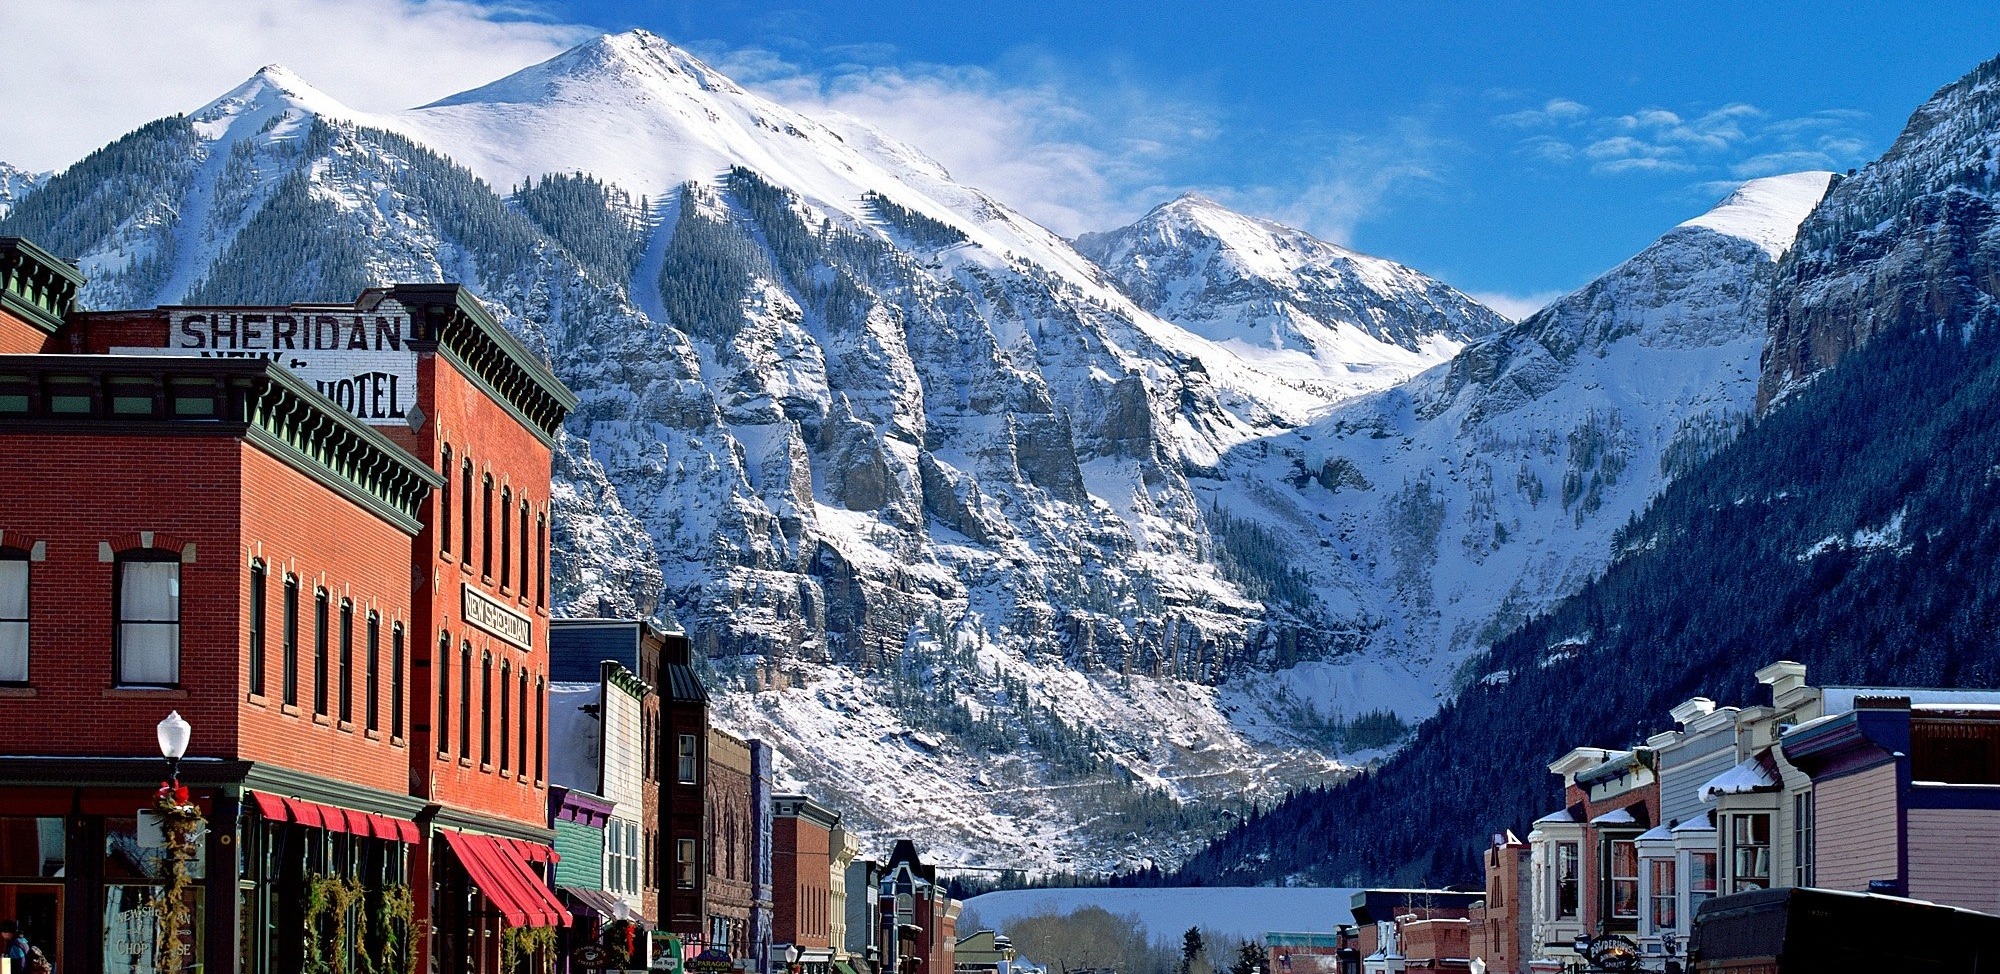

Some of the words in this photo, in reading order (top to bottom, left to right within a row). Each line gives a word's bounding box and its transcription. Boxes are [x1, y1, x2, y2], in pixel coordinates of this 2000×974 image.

[181, 314, 401, 351] SHERIDAN
[467, 592, 485, 622] NEW
[485, 603, 529, 645] SHERIDAN
[117, 909, 138, 923] NEW
